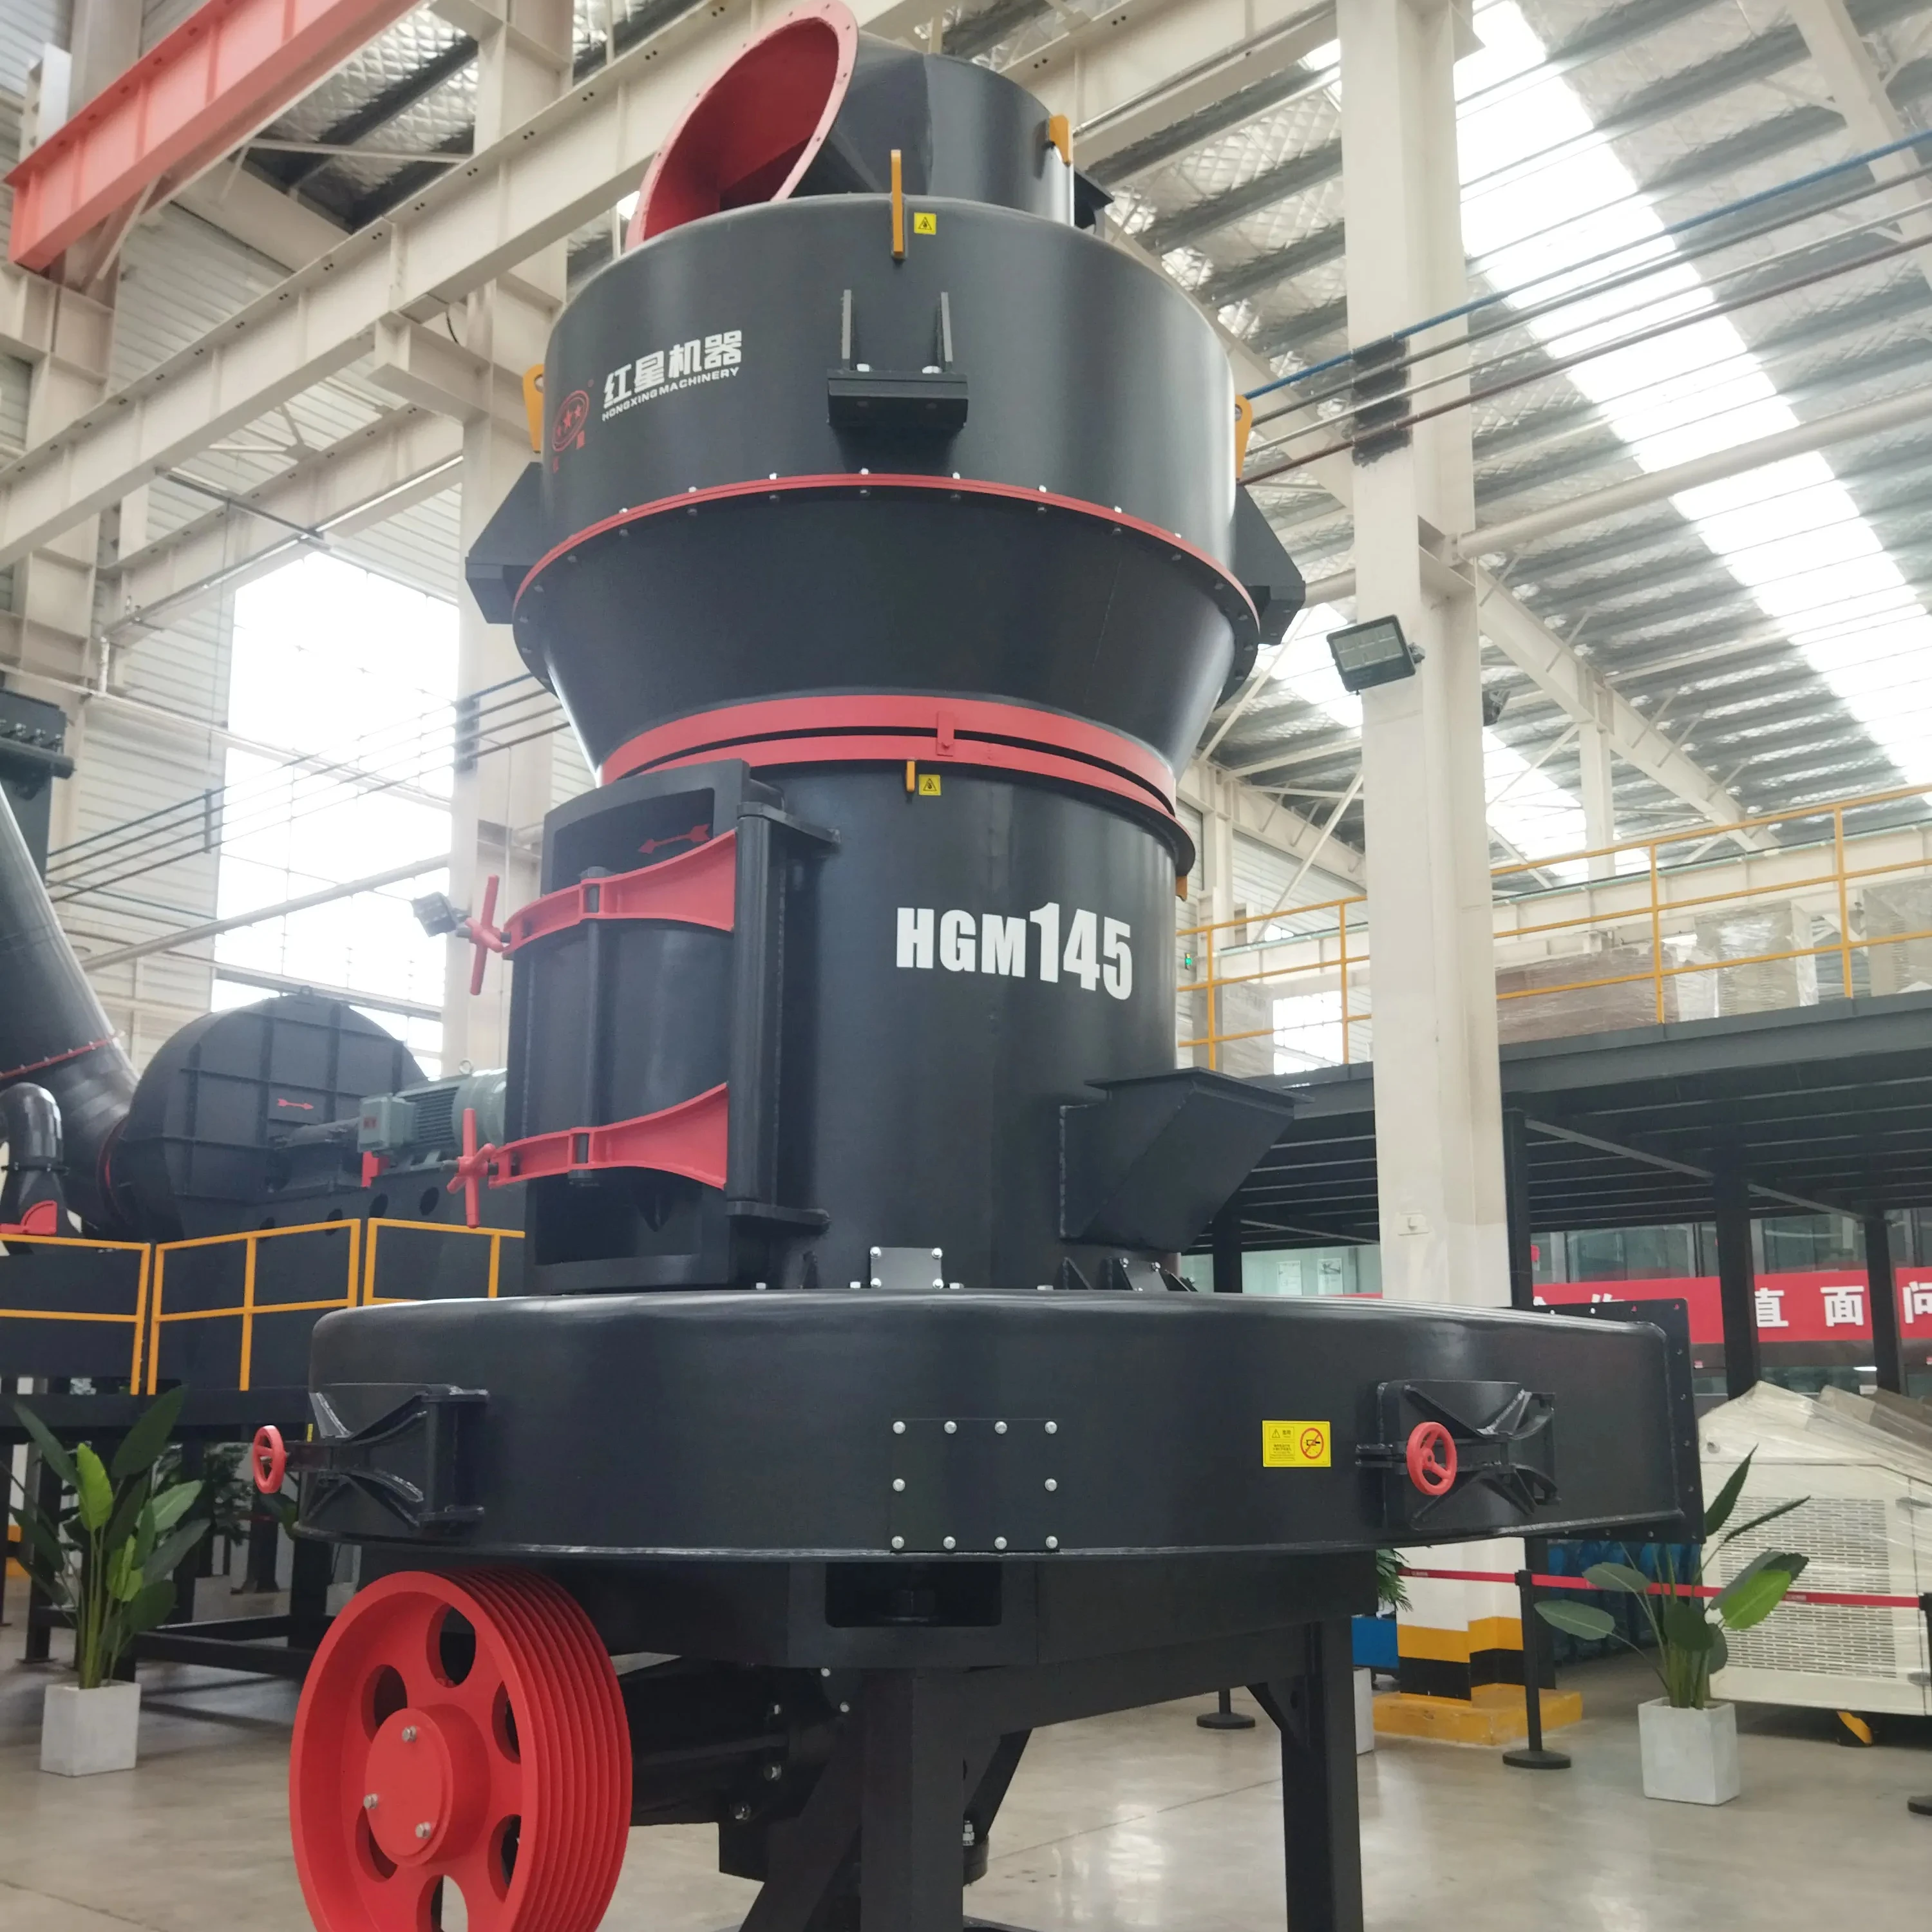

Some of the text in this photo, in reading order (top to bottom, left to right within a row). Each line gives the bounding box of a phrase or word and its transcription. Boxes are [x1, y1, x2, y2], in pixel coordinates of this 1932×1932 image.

[603, 330, 742, 409] 红星机器
[896, 902, 1132, 1000] HGM145
